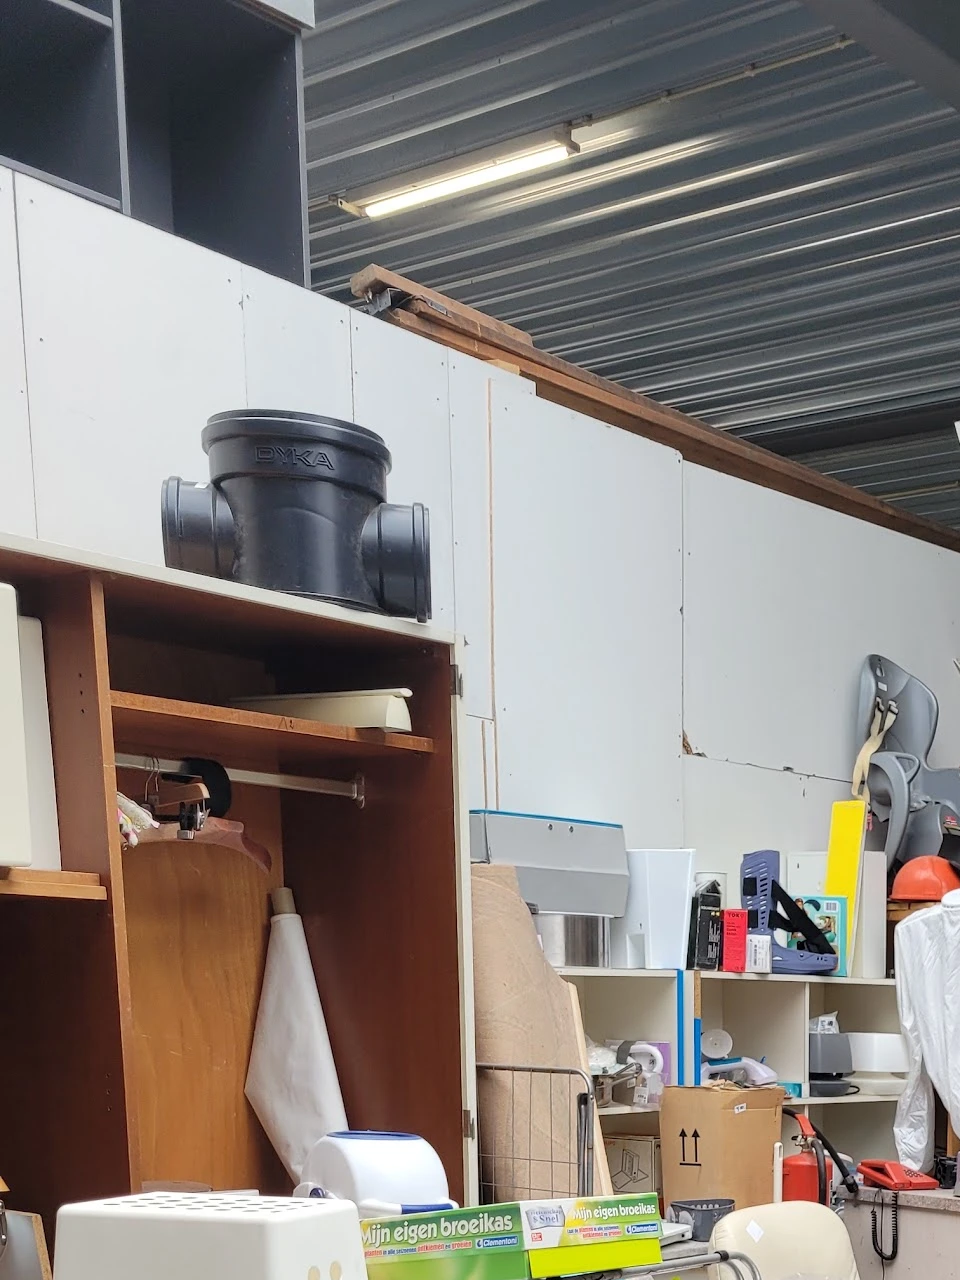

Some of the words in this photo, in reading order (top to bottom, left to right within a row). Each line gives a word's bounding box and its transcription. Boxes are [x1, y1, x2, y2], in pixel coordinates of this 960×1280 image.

[255, 446, 335, 471] DYKA
[572, 1206, 593, 1222] Mijn
[595, 1205, 619, 1220] eigen
[619, 1202, 656, 1217] broeikas
[362, 1224, 391, 1248] Mijn
[394, 1221, 437, 1245] eigen
[440, 1212, 514, 1237] broeikas
[483, 1236, 518, 1248] Clementoni
